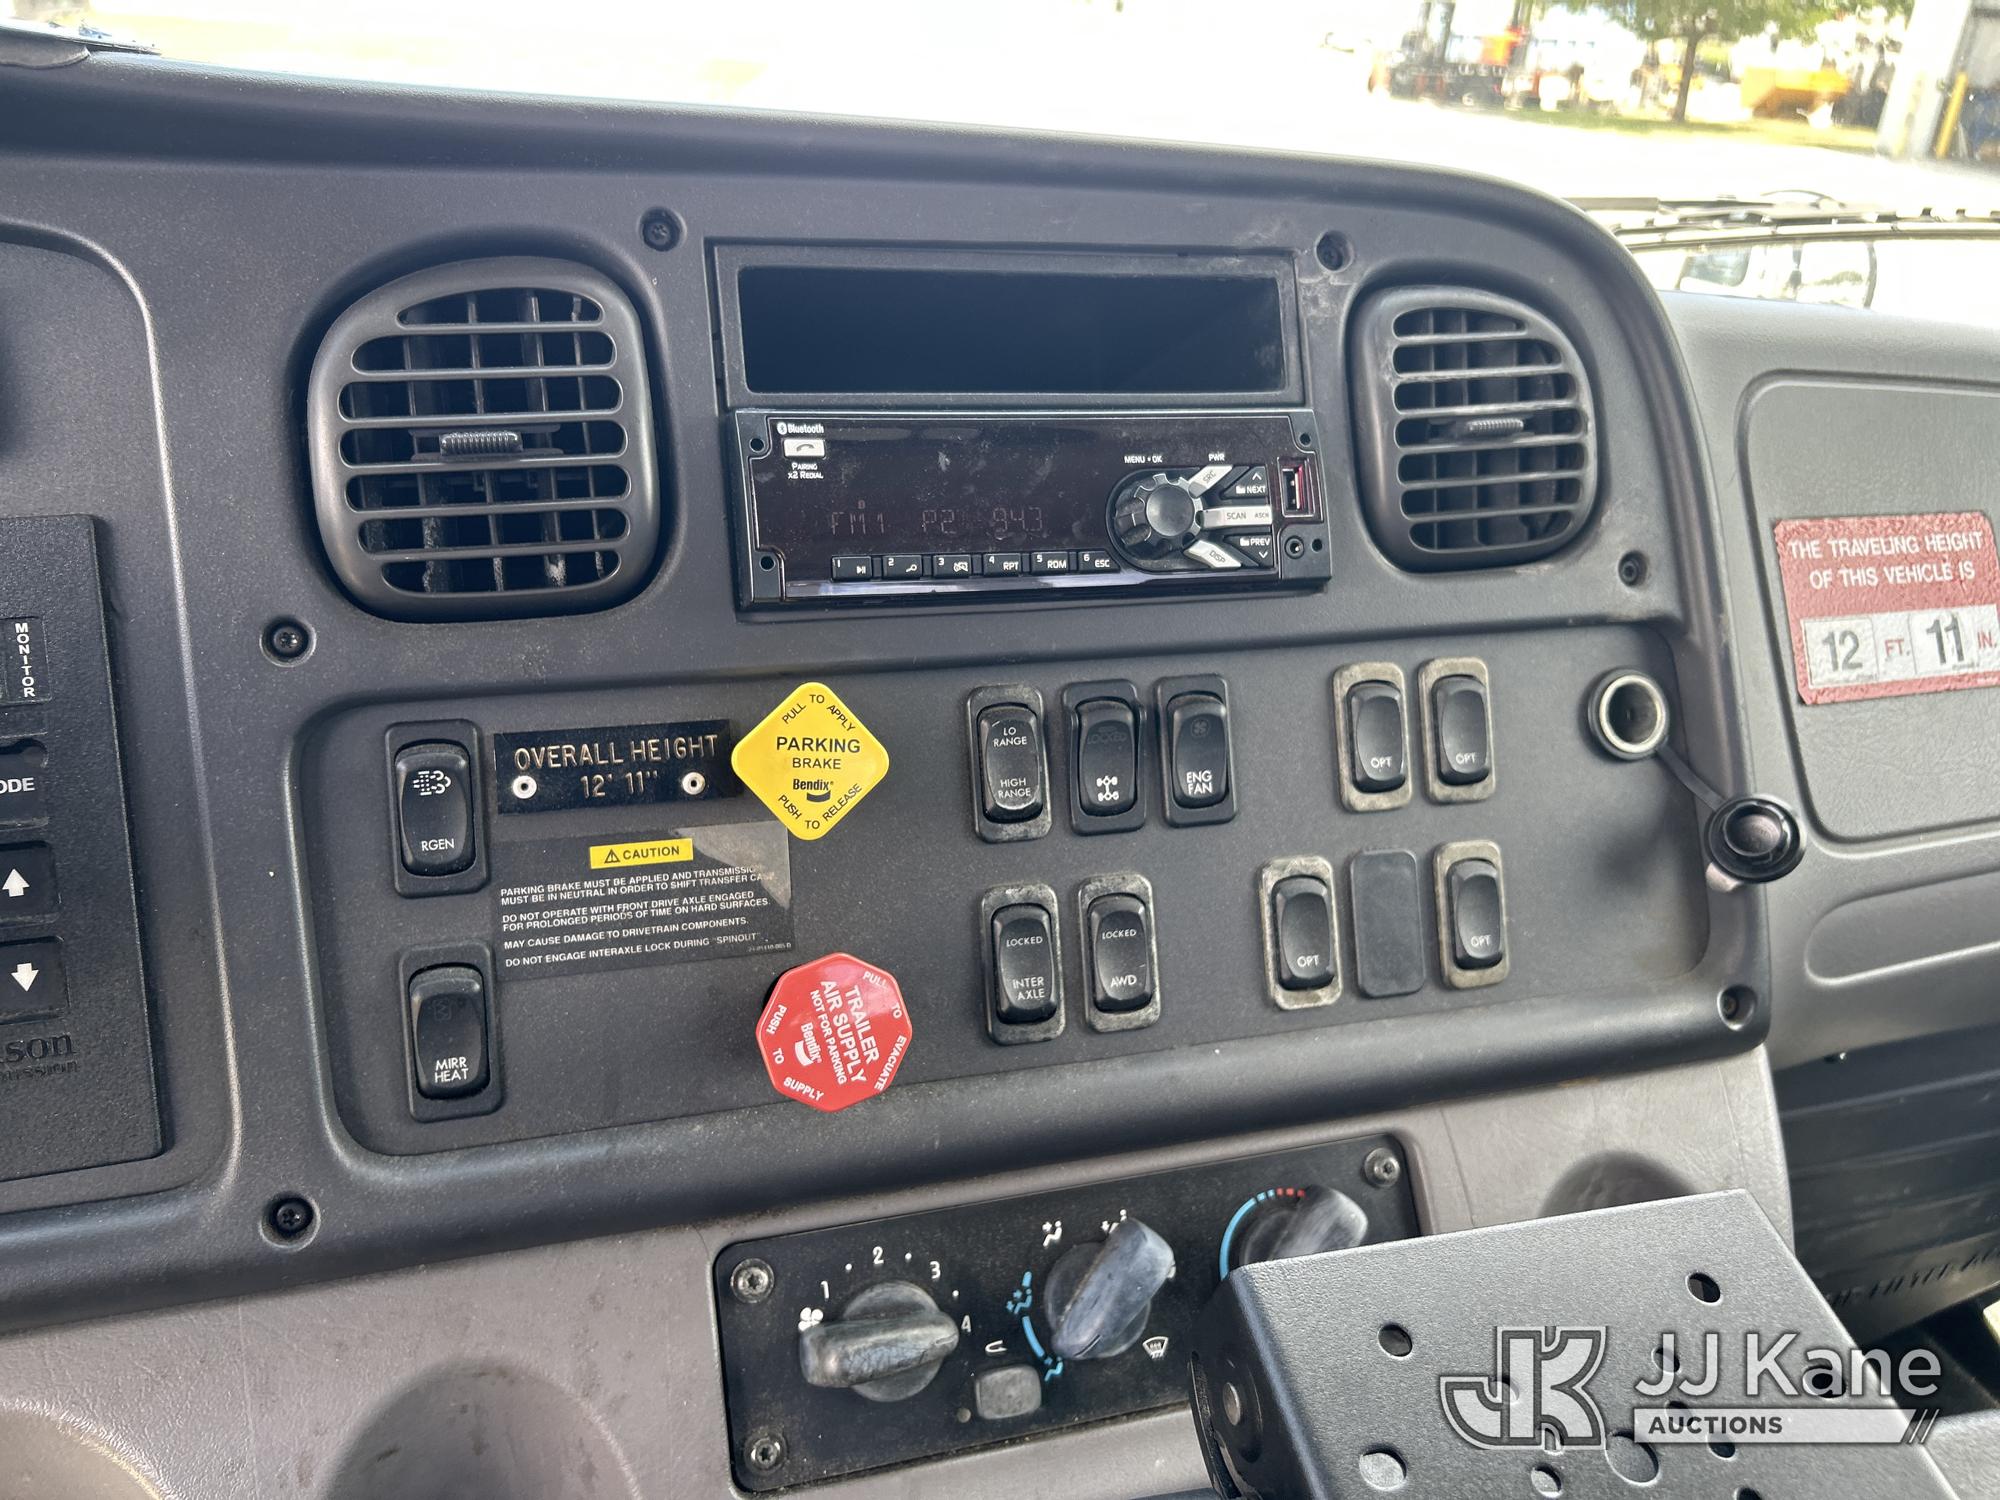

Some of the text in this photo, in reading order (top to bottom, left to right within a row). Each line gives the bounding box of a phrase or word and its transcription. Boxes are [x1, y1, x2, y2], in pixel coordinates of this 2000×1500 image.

[788, 423, 824, 434] Bluetooth
[1209, 453, 1226, 461] PWR
[1203, 471, 1217, 484] SRC
[1251, 538, 1270, 546] PREV
[1789, 531, 1983, 559] THE TRAVELING HEIGHT
[837, 559, 840, 567] 1
[889, 558, 894, 566] 2
[1209, 551, 1225, 563] DISP
[1003, 562, 1019, 570] RPT
[1809, 560, 1976, 590] OF THIS VEHICLE IS
[1822, 630, 1863, 672] 12
[1926, 612, 1964, 665] 11
[15, 622, 35, 697] MONITOR
[782, 694, 856, 732] PULL TO APPLY
[1003, 727, 1017, 736] LO
[776, 737, 860, 753] PARKING
[993, 736, 1027, 747] RANGE
[514, 734, 718, 770] OVERALL HEIGHT
[1456, 753, 1477, 764] OPT
[792, 758, 841, 769] BRAKE
[1370, 756, 1393, 768] OPT
[1000, 777, 1026, 787] HIGH
[1186, 771, 1213, 783] ENG
[998, 788, 1031, 798] RANGE
[1187, 782, 1213, 795] FAN
[778, 783, 862, 829] PUSH TO RELEASE
[421, 838, 454, 851] RGEN
[623, 846, 680, 860] CAUTION
[501, 885, 544, 896] PARKING
[548, 882, 581, 892] BRAKE
[584, 879, 610, 888] MUST
[614, 878, 626, 886] BE
[630, 874, 670, 885] APPLIED
[672, 871, 692, 880] AND
[502, 896, 528, 906] MUST
[532, 894, 545, 903] BE
[548, 893, 557, 901] IN
[560, 889, 605, 900] NEUTRAL
[608, 887, 617, 895] IN
[620, 884, 654, 894] ORDER
[656, 882, 668, 890] TO
[671, 879, 696, 889] SHIFT
[700, 875, 747, 886] TRANSFER
[502, 891, 754, 923] DO NOT OPERATE WITH FRONT DRIVE AXLE ENGAGED
[503, 922, 523, 931] FOR
[526, 917, 588, 929] PROLONGED
[591, 912, 633, 923] PERIODS
[636, 910, 648, 918] OF
[650, 906, 672, 916] TIME
[691, 903, 717, 912] HARD
[504, 941, 524, 950] MAY
[528, 937, 560, 947] CAUSE
[564, 931, 604, 943] DAMAGE
[608, 930, 620, 938] TO
[622, 924, 679, 936] DRIVETRAIN
[1006, 936, 1043, 947] LOCKED
[1102, 929, 1137, 940] LOCKED
[1471, 935, 1491, 947] OPT
[506, 959, 520, 967] DO
[523, 956, 543, 965] NOT
[546, 952, 586, 963] ENGAGE
[589, 945, 642, 957] INTERAXLE
[645, 942, 671, 952] LOCK
[674, 938, 710, 949] DURING
[1297, 955, 1320, 967] OPT
[1013, 976, 1044, 989] INTER
[1110, 975, 1137, 988] AWD
[1017, 988, 1045, 1000] AXLE
[821, 981, 867, 1082] AIR SUPPLY
[845, 985, 879, 1064] TRAILER
[863, 971, 907, 1091] PULL TO EVACUATE
[810, 990, 847, 1085] NOT FOR PARKING
[766, 1004, 824, 1101] PUSH TO SUPPLY
[435, 1057, 467, 1071] MIRR
[435, 1068, 469, 1083] HEAT
[872, 1246, 884, 1264] 2
[930, 1261, 941, 1279] 3
[821, 1281, 830, 1299] 1
[961, 1315, 972, 1333] 4
